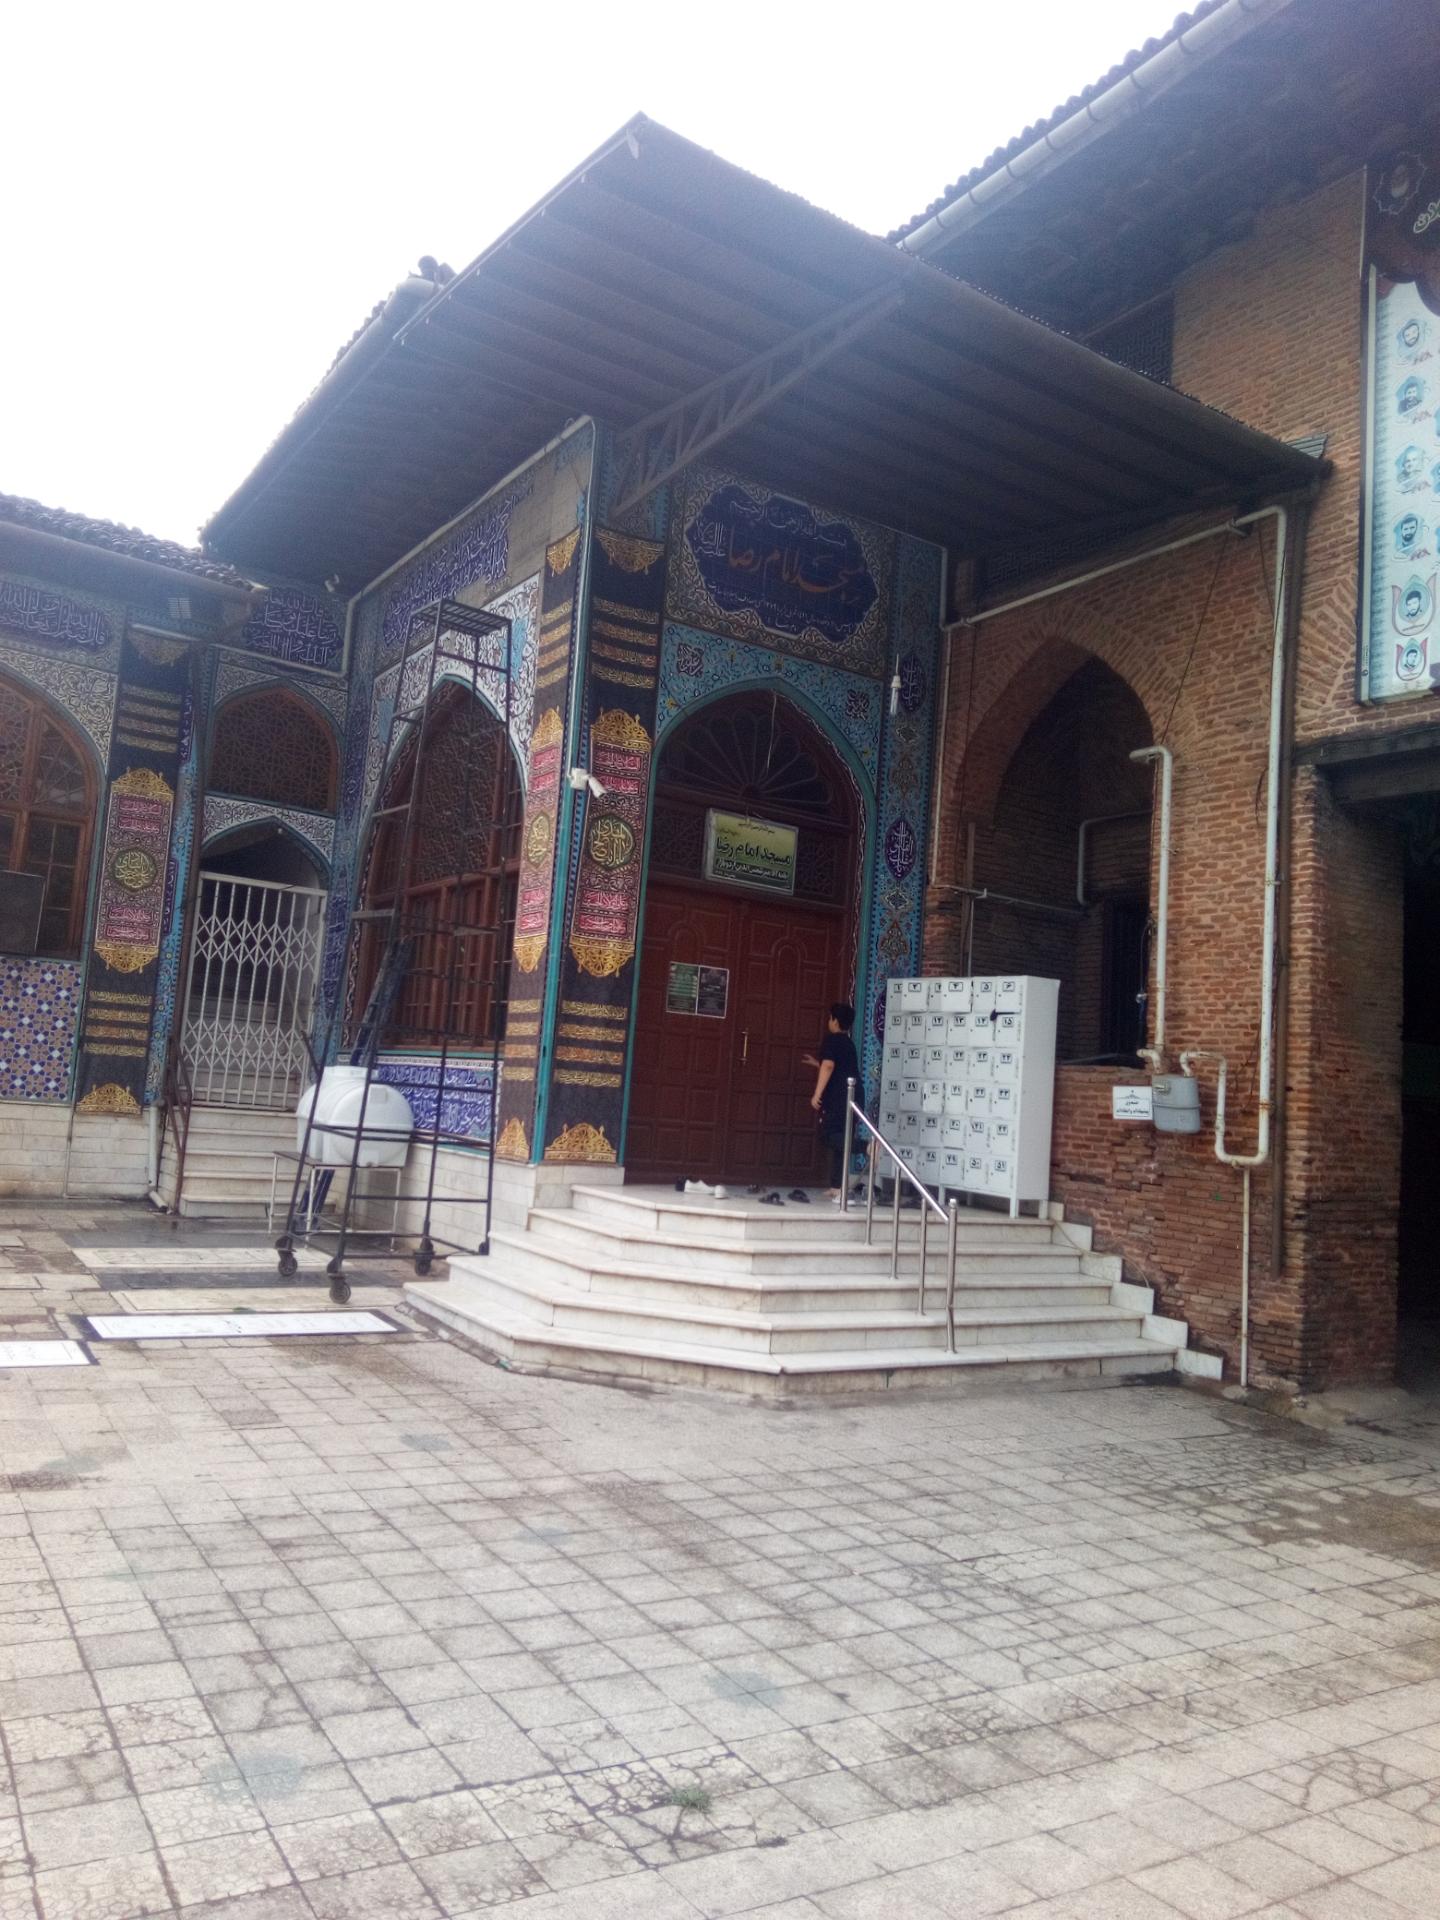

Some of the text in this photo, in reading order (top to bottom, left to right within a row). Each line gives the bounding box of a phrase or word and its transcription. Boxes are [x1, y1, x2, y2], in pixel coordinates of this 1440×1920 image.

[716, 836, 791, 865] مسجد امام رضا
